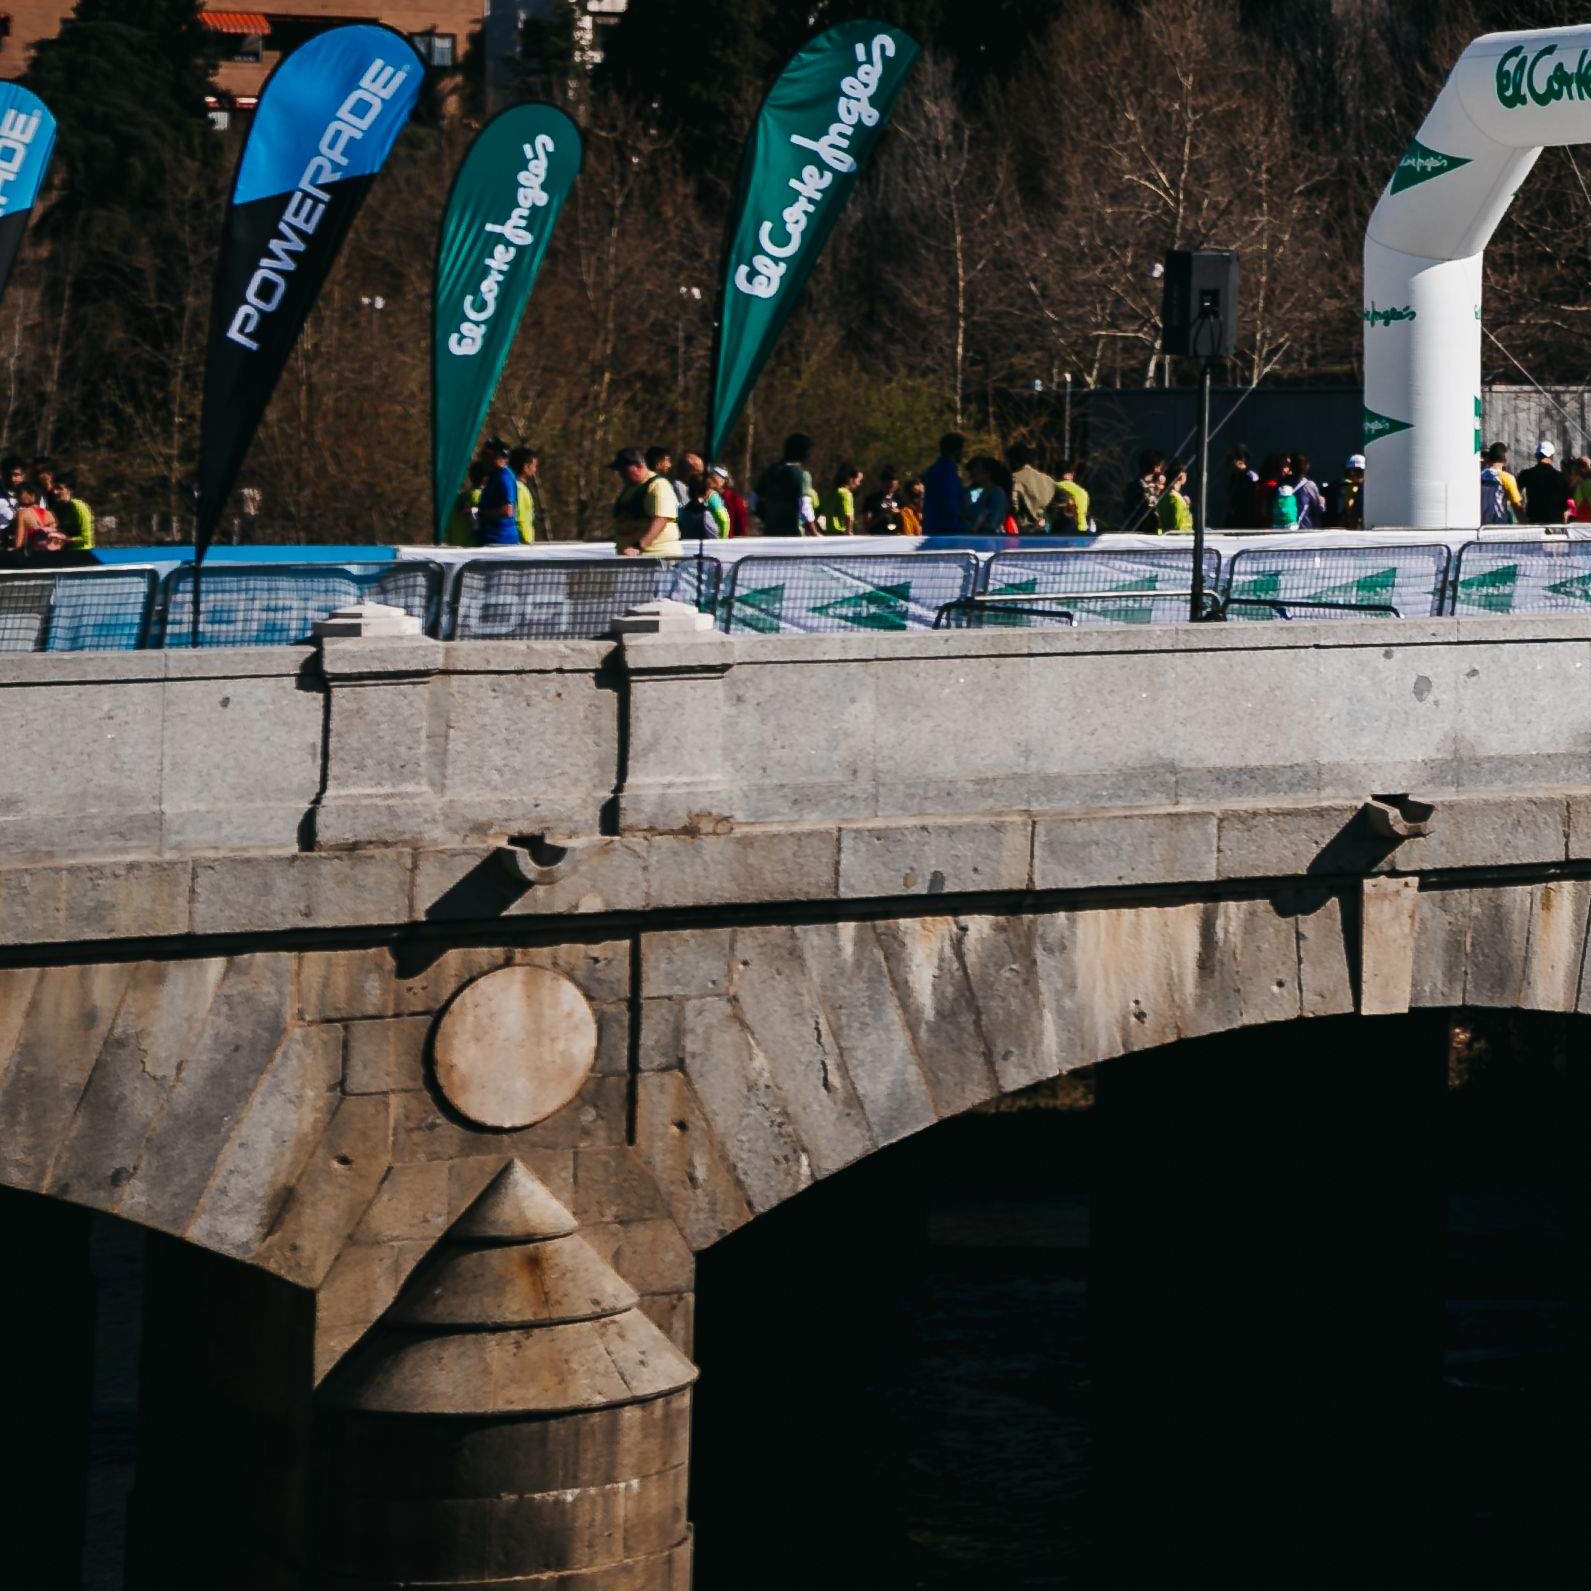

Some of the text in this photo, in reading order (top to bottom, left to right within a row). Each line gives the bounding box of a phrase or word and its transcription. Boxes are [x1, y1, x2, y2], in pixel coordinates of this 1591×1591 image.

[733, 34, 896, 299] El Corte Inglés
[1495, 44, 1528, 109] El
[226, 58, 408, 351] POWERADE
[448, 133, 555, 355] El Corte Inglés
